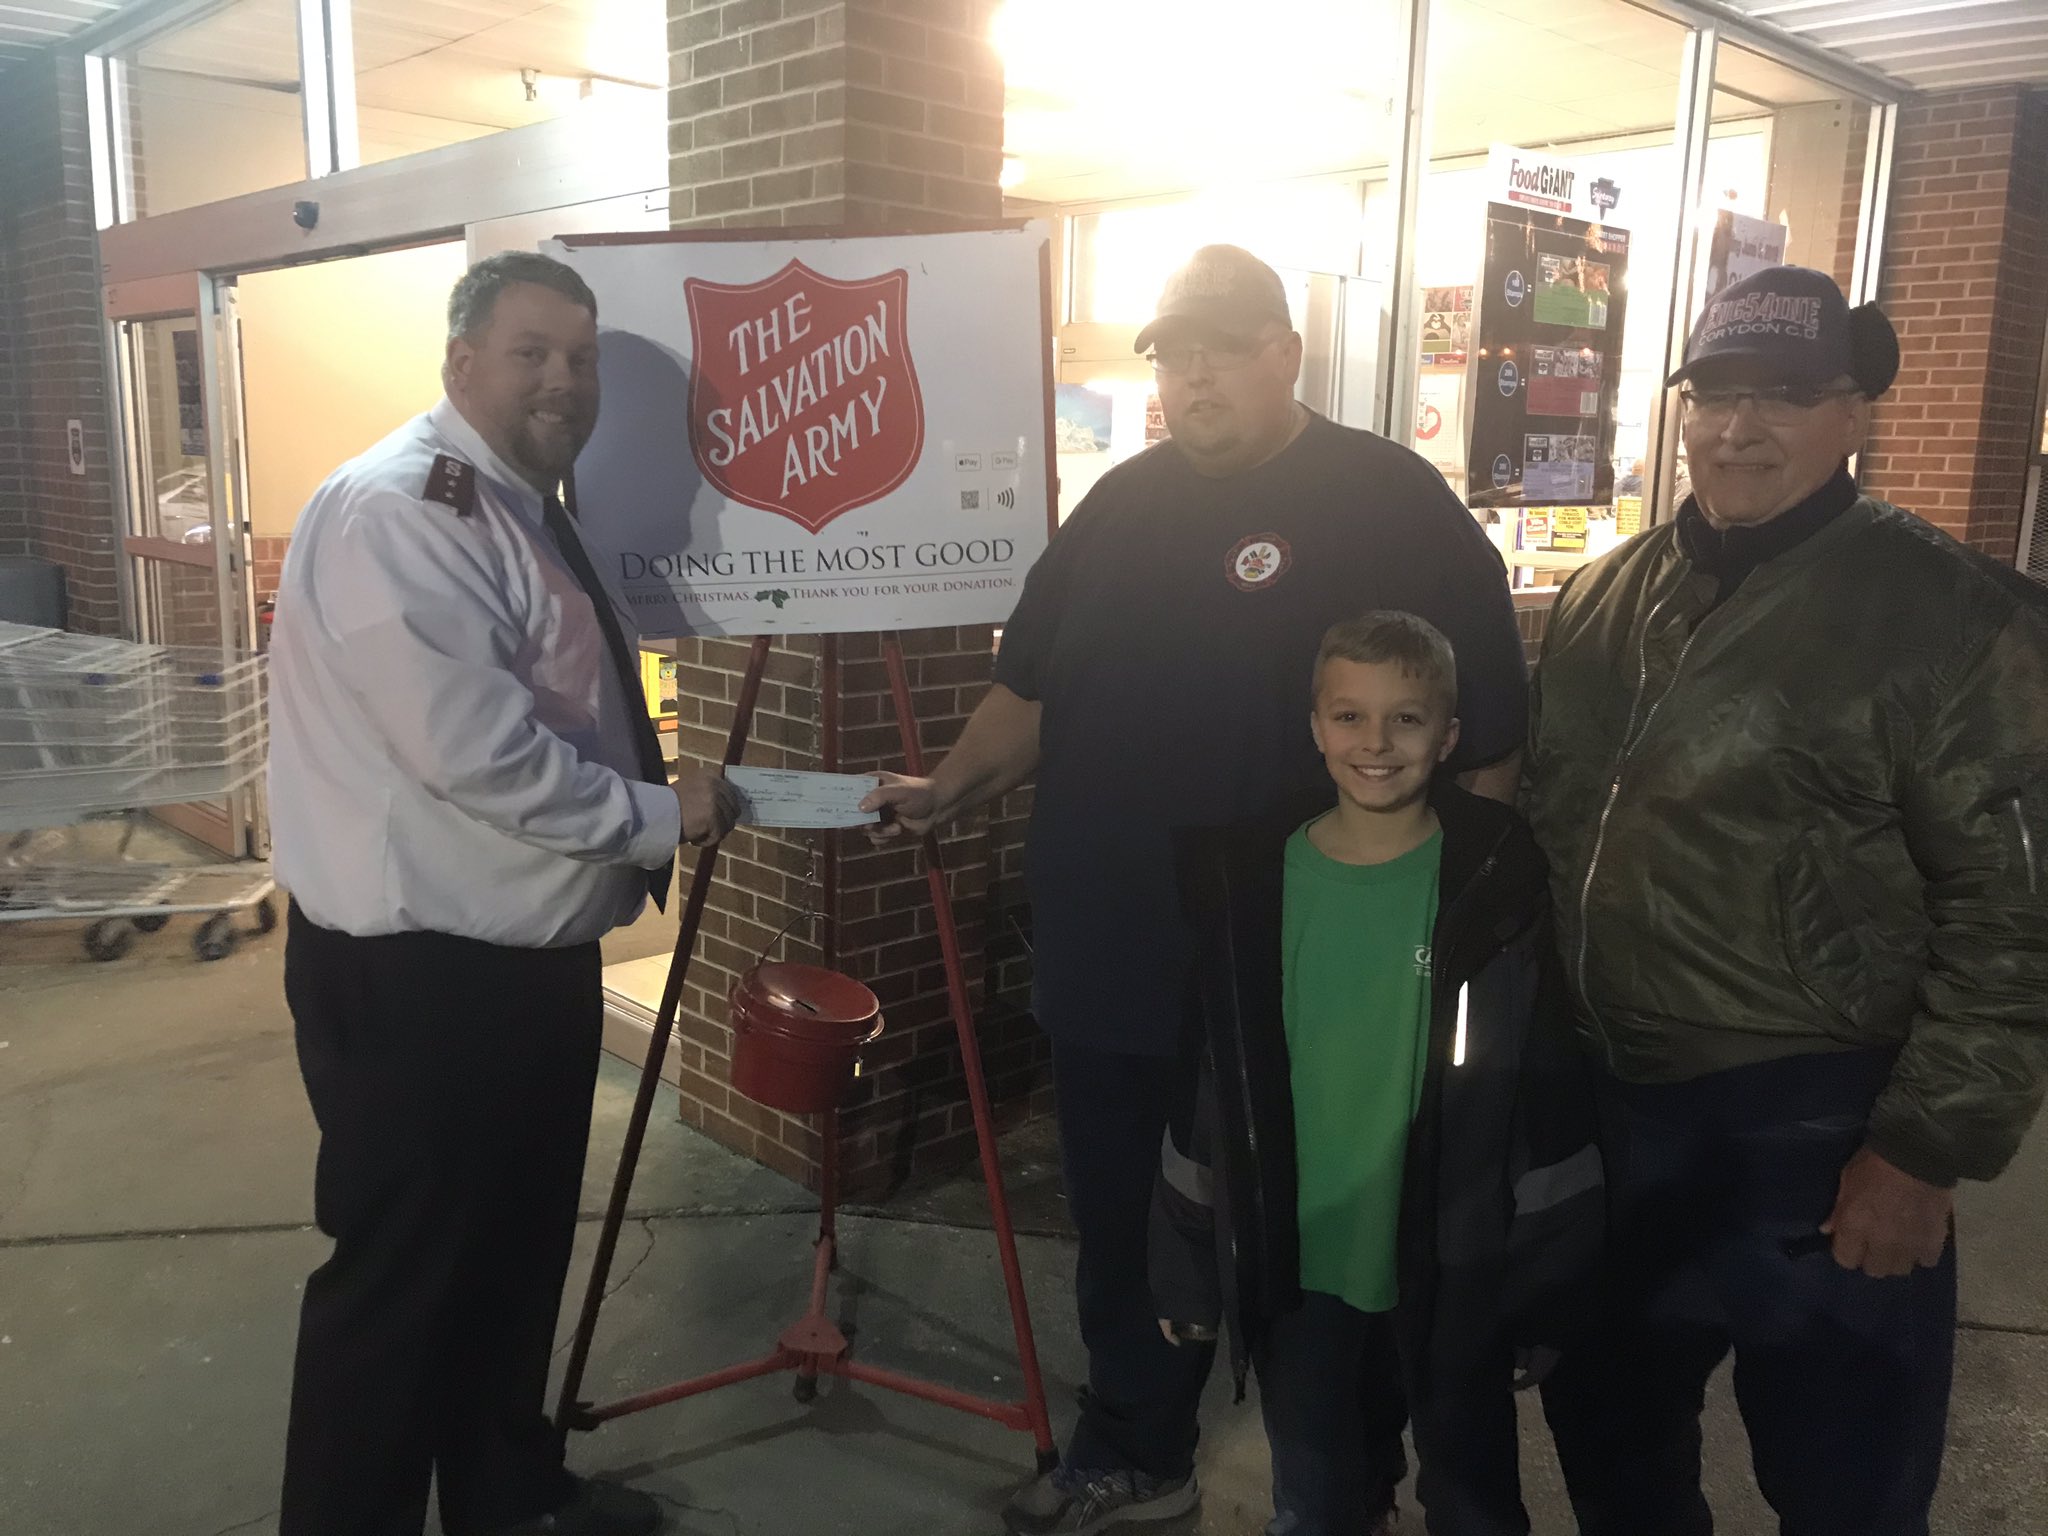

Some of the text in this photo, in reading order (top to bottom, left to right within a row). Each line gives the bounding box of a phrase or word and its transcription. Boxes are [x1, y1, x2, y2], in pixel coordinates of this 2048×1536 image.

[729, 292, 812, 376] THE
[1702, 292, 1821, 334] ENG54INE
[1699, 323, 1780, 346] CORYDON
[707, 300, 890, 466] SALVATION
[780, 376, 887, 499] ARMY
[620, 538, 1014, 580] DOING THE MOST GOOD
[627, 594, 667, 605] MERRY
[791, 577, 1016, 599] THANK YOU FOR YOUR DONATION.
